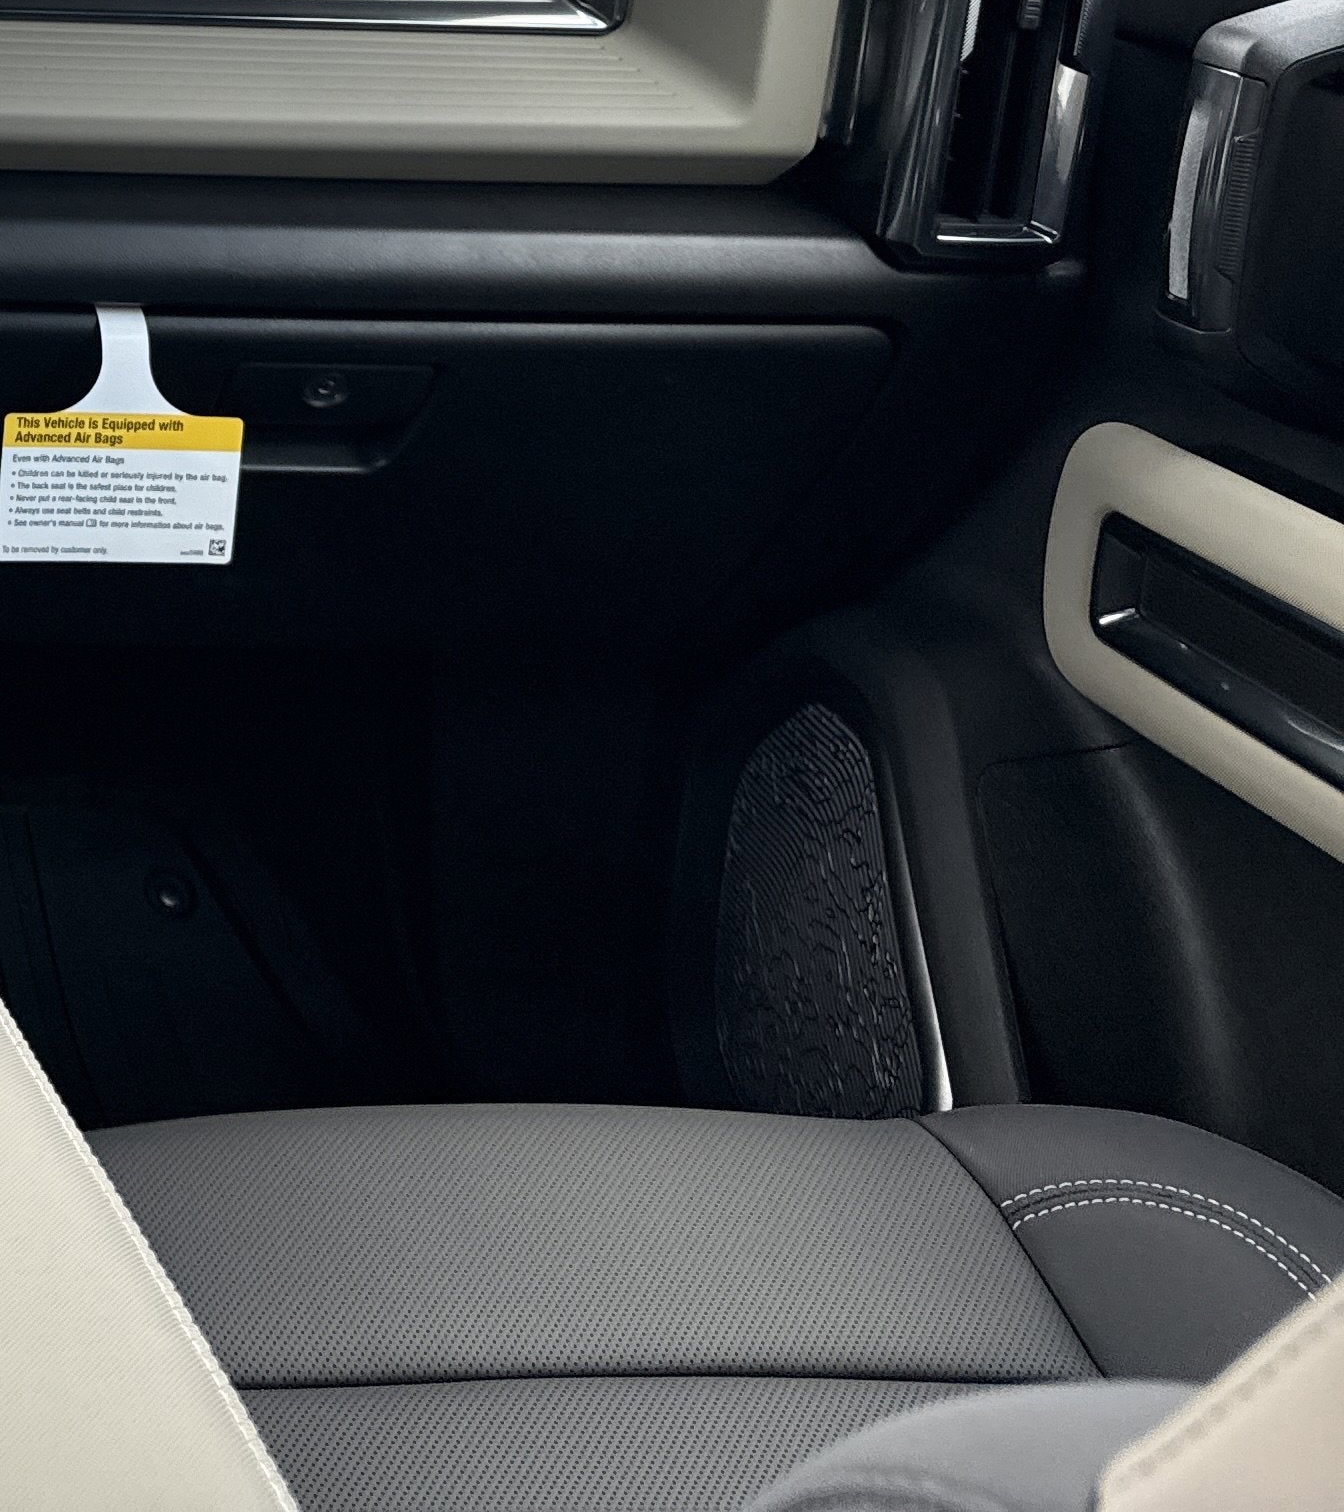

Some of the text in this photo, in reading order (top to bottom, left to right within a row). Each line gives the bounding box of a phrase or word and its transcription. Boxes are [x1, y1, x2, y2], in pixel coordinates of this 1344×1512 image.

[17, 416, 41, 429] This
[43, 416, 85, 429] Vehicle
[102, 417, 156, 433] Equipped
[159, 419, 184, 432] with
[15, 431, 124, 447] Advanced Air Bags
[12, 454, 125, 465] Even with Advanced Air Bags
[18, 469, 49, 477] Children
[66, 470, 76, 478] be
[77, 470, 99, 478] killed
[110, 471, 144, 481] seriously
[146, 472, 172, 481] injured
[174, 472, 184, 481] by
[17, 482, 31, 490] The
[32, 482, 49, 490] back
[75, 482, 88, 490] the
[89, 483, 112, 491] safest
[113, 484, 133, 492] place
[38, 495, 50, 503] put
[58, 495, 98, 504] rear-facing
[99, 495, 117, 503] child
[15, 506, 40, 515] Always
[92, 508, 107, 516] and
[108, 508, 126, 516] child
[13, 519, 27, 527] See
[28, 519, 57, 527] owner's
[58, 519, 84, 527] manual
[99, 519, 109, 527] for
[130, 521, 171, 530] information
[2, 545, 10, 553] To
[11, 545, 20, 553] be
[21, 545, 50, 553] removed
[51, 546, 59, 555] by
